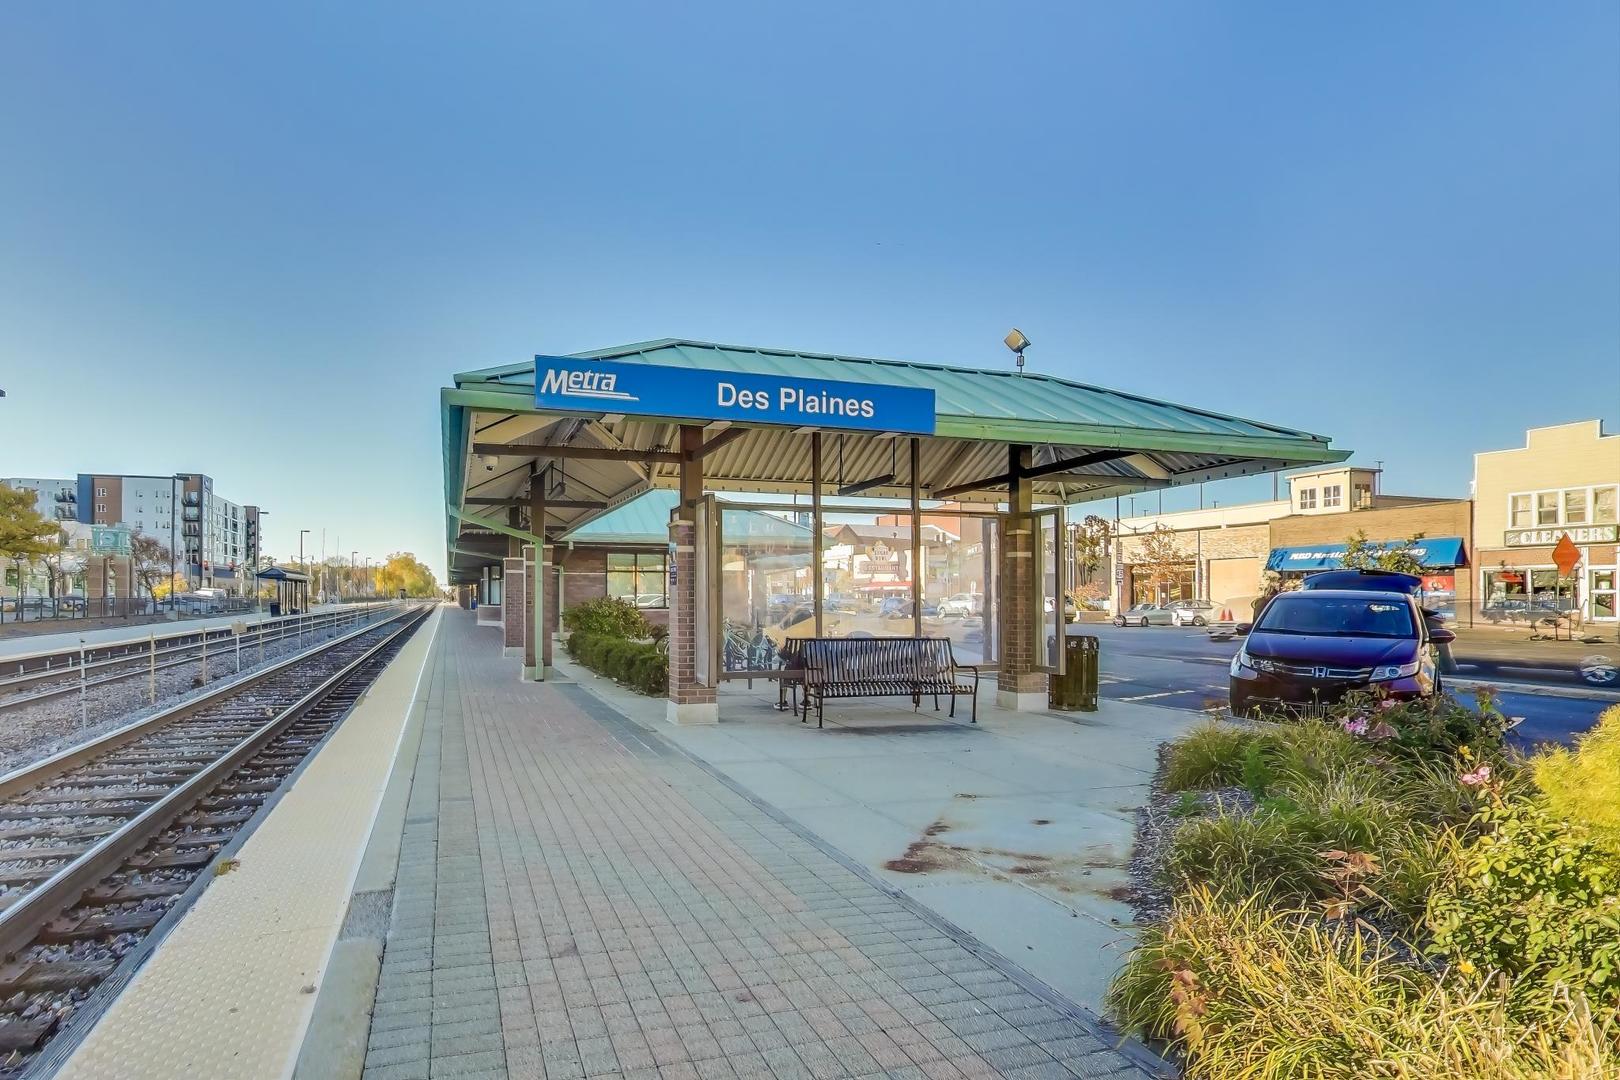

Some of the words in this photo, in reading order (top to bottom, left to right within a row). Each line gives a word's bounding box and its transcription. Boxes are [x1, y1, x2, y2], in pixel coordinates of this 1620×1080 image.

[541, 369, 617, 396] Metra
[718, 382, 769, 410] Des
[780, 387, 874, 418] Plaines
